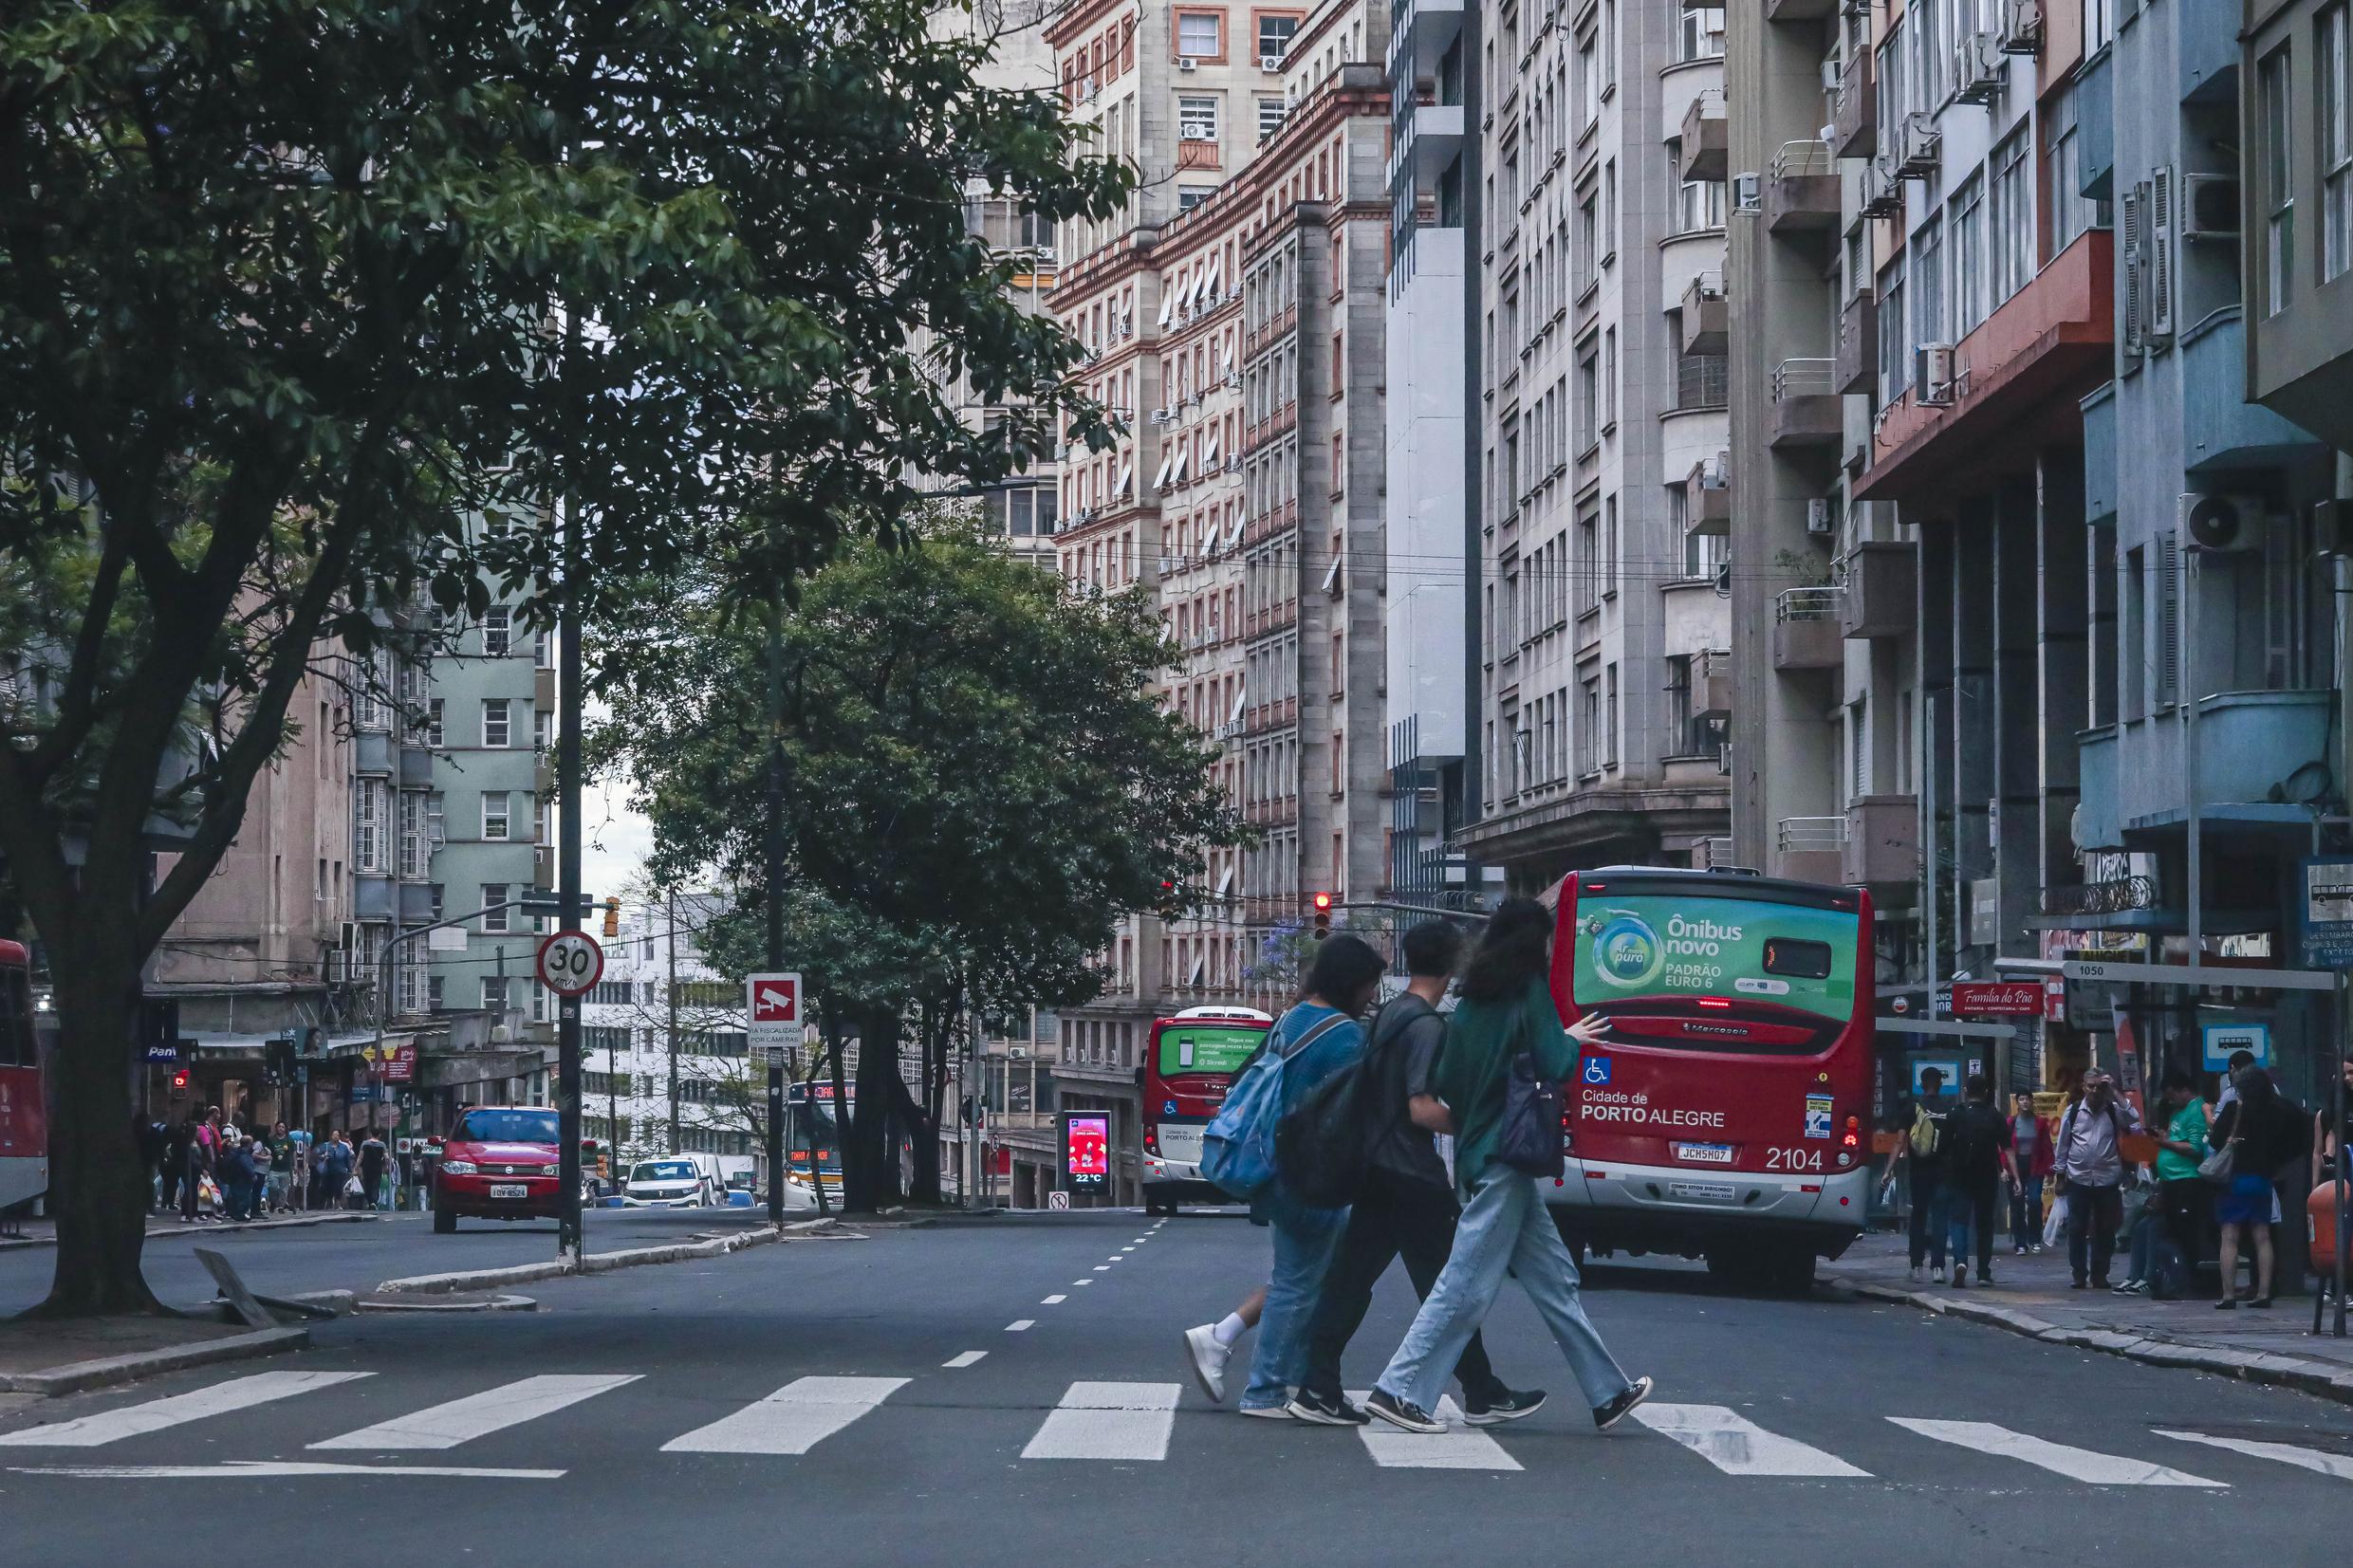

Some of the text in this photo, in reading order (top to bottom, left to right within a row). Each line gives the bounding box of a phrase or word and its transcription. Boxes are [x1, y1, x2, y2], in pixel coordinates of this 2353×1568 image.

[1668, 913, 1742, 941] Ônibus
[1667, 940, 1720, 956] novo
[550, 944, 589, 975] 30
[1615, 953, 1643, 964] puro
[1666, 963, 1721, 977] PADRÃO
[2080, 966, 2103, 975] 1050
[1665, 975, 1714, 988] EURO 6
[2001, 987, 2012, 1003] do
[1582, 1089, 1648, 1105] Cidade de
[1581, 1105, 1725, 1128] PORTO ALEGRE
[1766, 1147, 1822, 1170] 2104
